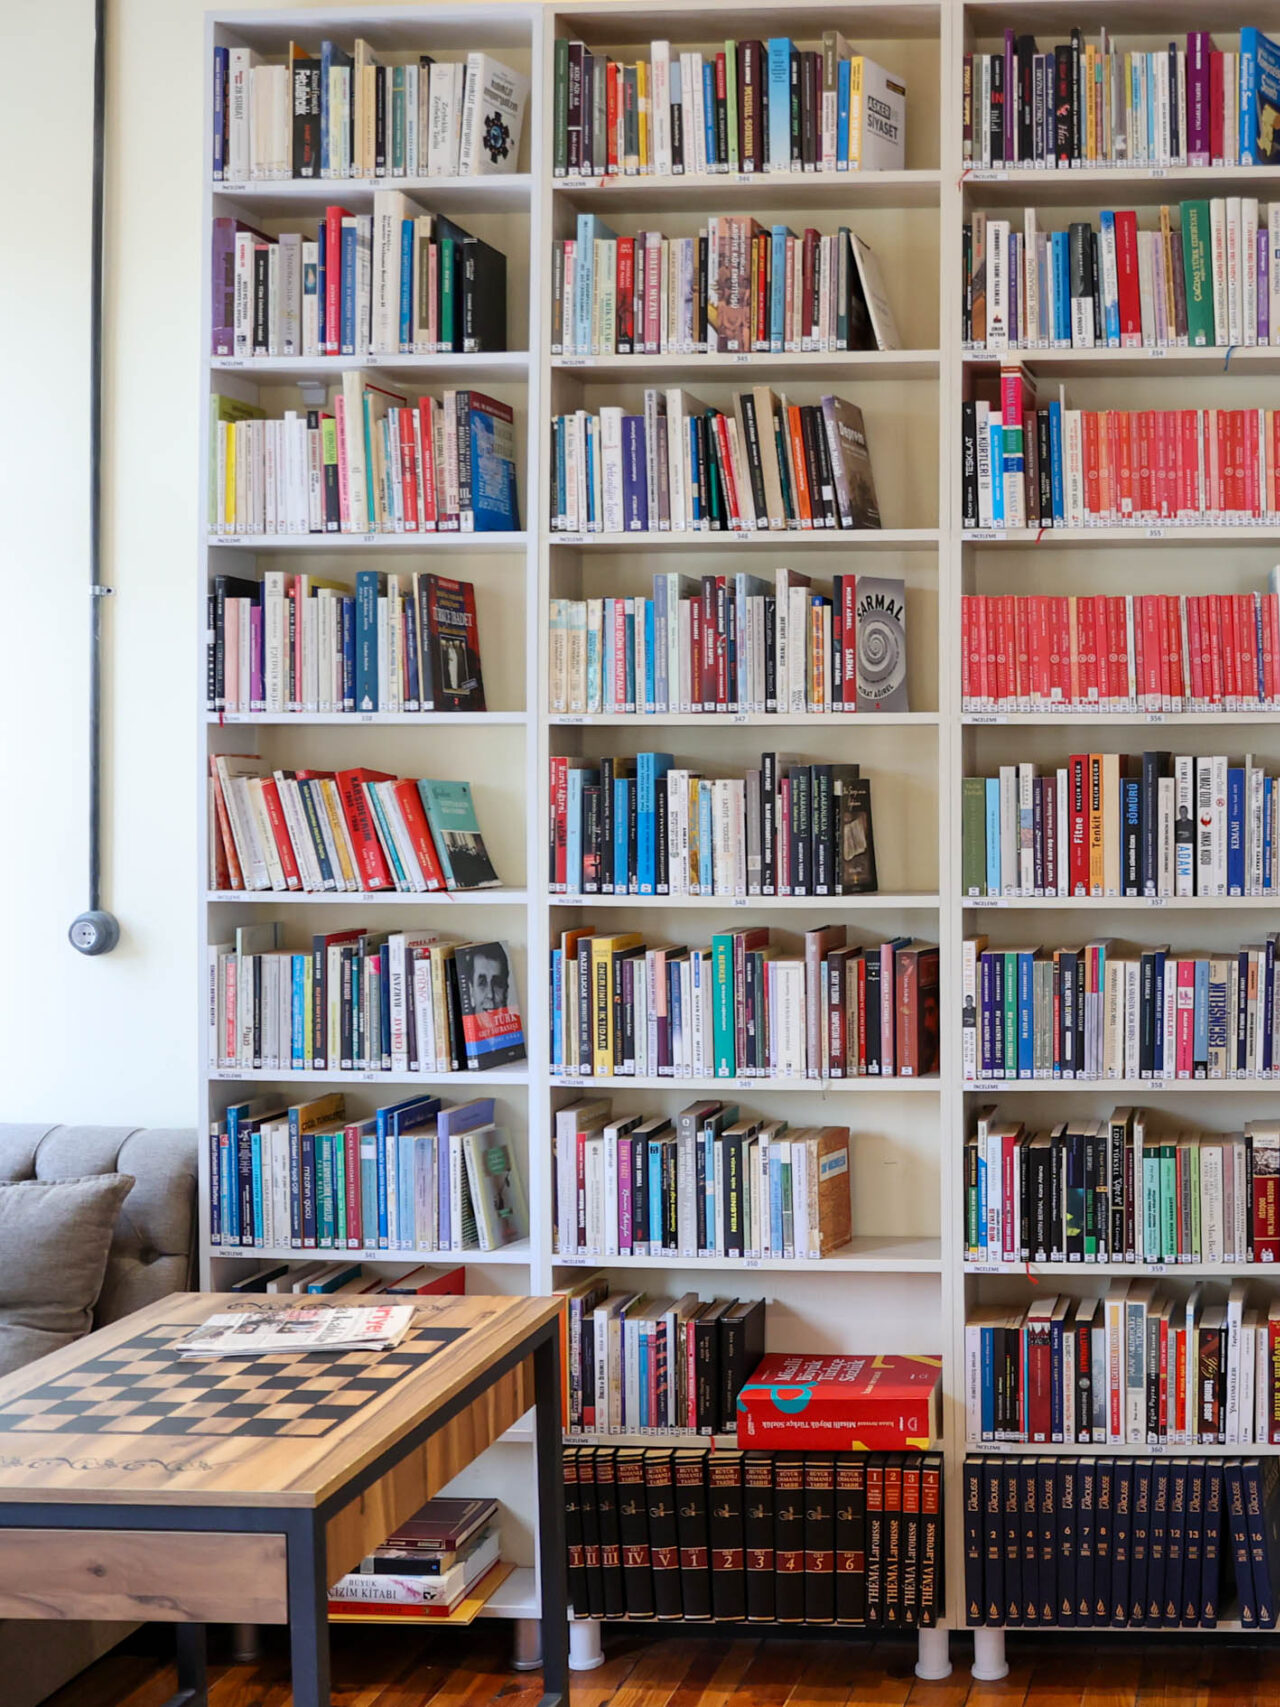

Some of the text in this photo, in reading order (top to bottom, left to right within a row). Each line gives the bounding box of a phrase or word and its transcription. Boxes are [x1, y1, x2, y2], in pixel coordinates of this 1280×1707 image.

[744, 86, 753, 156] MUSUL SORUNU
[966, 437, 974, 476] TEŞKİLAT
[858, 594, 903, 622] SARMAL
[616, 650, 624, 659] VE
[845, 649, 854, 681] SARMAL
[616, 661, 624, 699] HAFTALAR
[1199, 768, 1210, 790] YILMAZ
[1127, 784, 1138, 824] SÖMÜRÜ
[1074, 817, 1083, 843] Fitne
[1092, 816, 1101, 848] Tenkit
[1200, 831, 1210, 848] ANKA
[1178, 846, 1189, 876] ADAM
[580, 952, 588, 973] NAZLI
[718, 955, 726, 984] BERKES
[1210, 983, 1227, 1047] EŞCİNSELLİK
[394, 1018, 402, 1050] CEMAAT
[1112, 1128, 1121, 1176] EDİP YÜKSEL
[304, 1167, 313, 1218] mizahın gücü
[774, 1359, 803, 1381] Misalli
[908, 1474, 914, 1482] 3
[970, 1477, 978, 1511] LAROUSSE
[1027, 1478, 1035, 1512] LAROUSSE
[1120, 1480, 1128, 1514] LAROUSSE
[1232, 1481, 1242, 1515] LAROUSSE
[990, 1530, 996, 1538] 2
[1008, 1530, 1014, 1538] 3
[1026, 1530, 1032, 1538] 4
[1064, 1526, 1070, 1534] 6
[1100, 1527, 1106, 1535] 8
[1119, 1532, 1124, 1540] 9
[1136, 1530, 1145, 1538] 10
[1170, 1530, 1180, 1538] 12
[586, 1554, 596, 1564] II
[604, 1553, 618, 1564] III
[628, 1552, 644, 1564] IV
[659, 1554, 670, 1566] V
[692, 1555, 697, 1566] 1
[724, 1556, 732, 1568] 2
[756, 1556, 764, 1568] 3
[786, 1558, 794, 1570] 4
[814, 1558, 822, 1570] 5
[846, 1558, 854, 1570] 6
[866, 1520, 880, 1604] THÉMA Larousse
[885, 1520, 898, 1604] THÉMA Larousse
[902, 1522, 916, 1606] THÉMA Larousse
[920, 1522, 936, 1607] THÉMA Larousse
[361, 1587, 397, 1600] KİTABI
